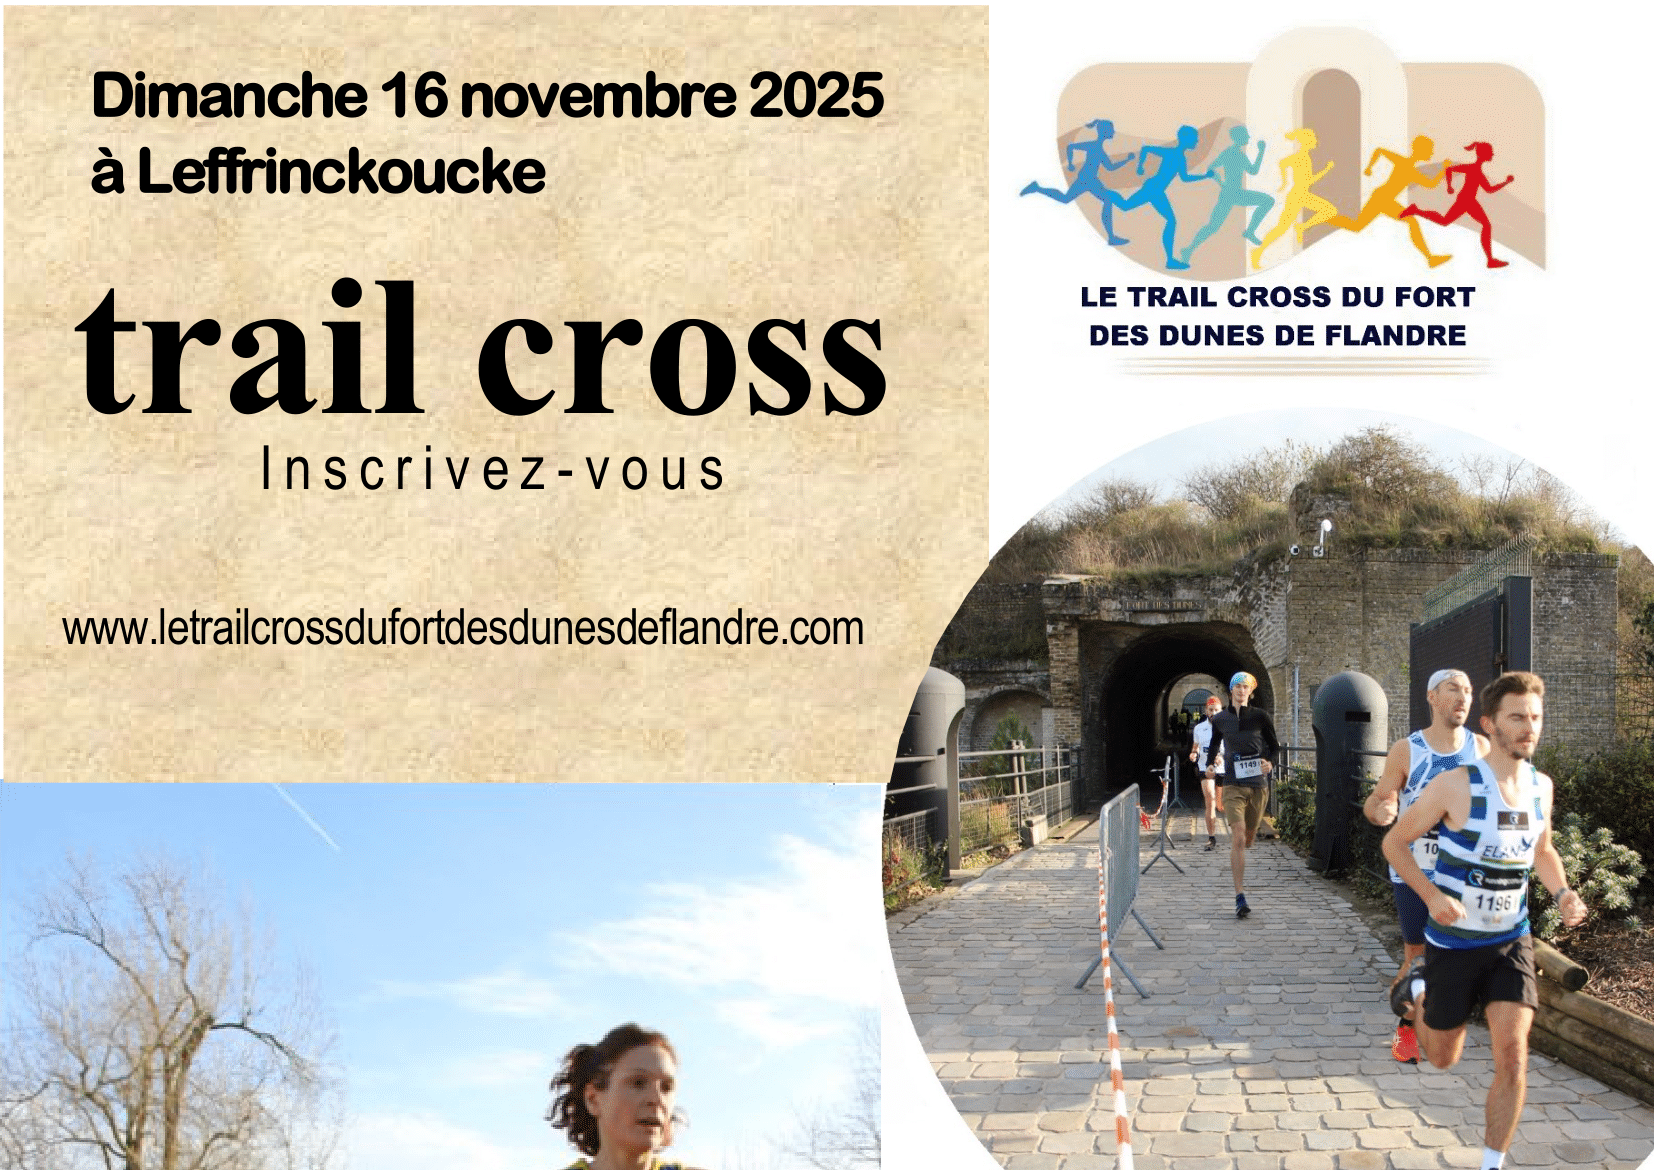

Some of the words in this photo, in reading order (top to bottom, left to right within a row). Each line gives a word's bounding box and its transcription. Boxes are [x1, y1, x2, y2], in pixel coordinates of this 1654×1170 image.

[94, 71, 367, 118] Dimanche
[382, 71, 448, 118] 16
[462, 71, 737, 118] novembre
[750, 71, 884, 118] 2025
[92, 147, 125, 194] à
[140, 147, 546, 194] Leffrinckoucke
[1082, 287, 1117, 307] LE
[1127, 287, 1217, 307] TRAIL
[1228, 286, 1331, 307] CROSS
[1343, 287, 1383, 307] DU
[1396, 286, 1475, 307] FORT
[75, 277, 425, 414] trail
[479, 319, 886, 416] cross
[1091, 325, 1148, 345] DES
[1160, 325, 1264, 345] DUNES
[1276, 325, 1314, 345] DE
[1326, 325, 1466, 345] FLANDRE
[264, 445, 722, 490] Inscrivez-vous
[62, 608, 863, 645] www.letrailcrossdufortdesdunesdeflandre.com
[1475, 894, 1511, 911] 1196
